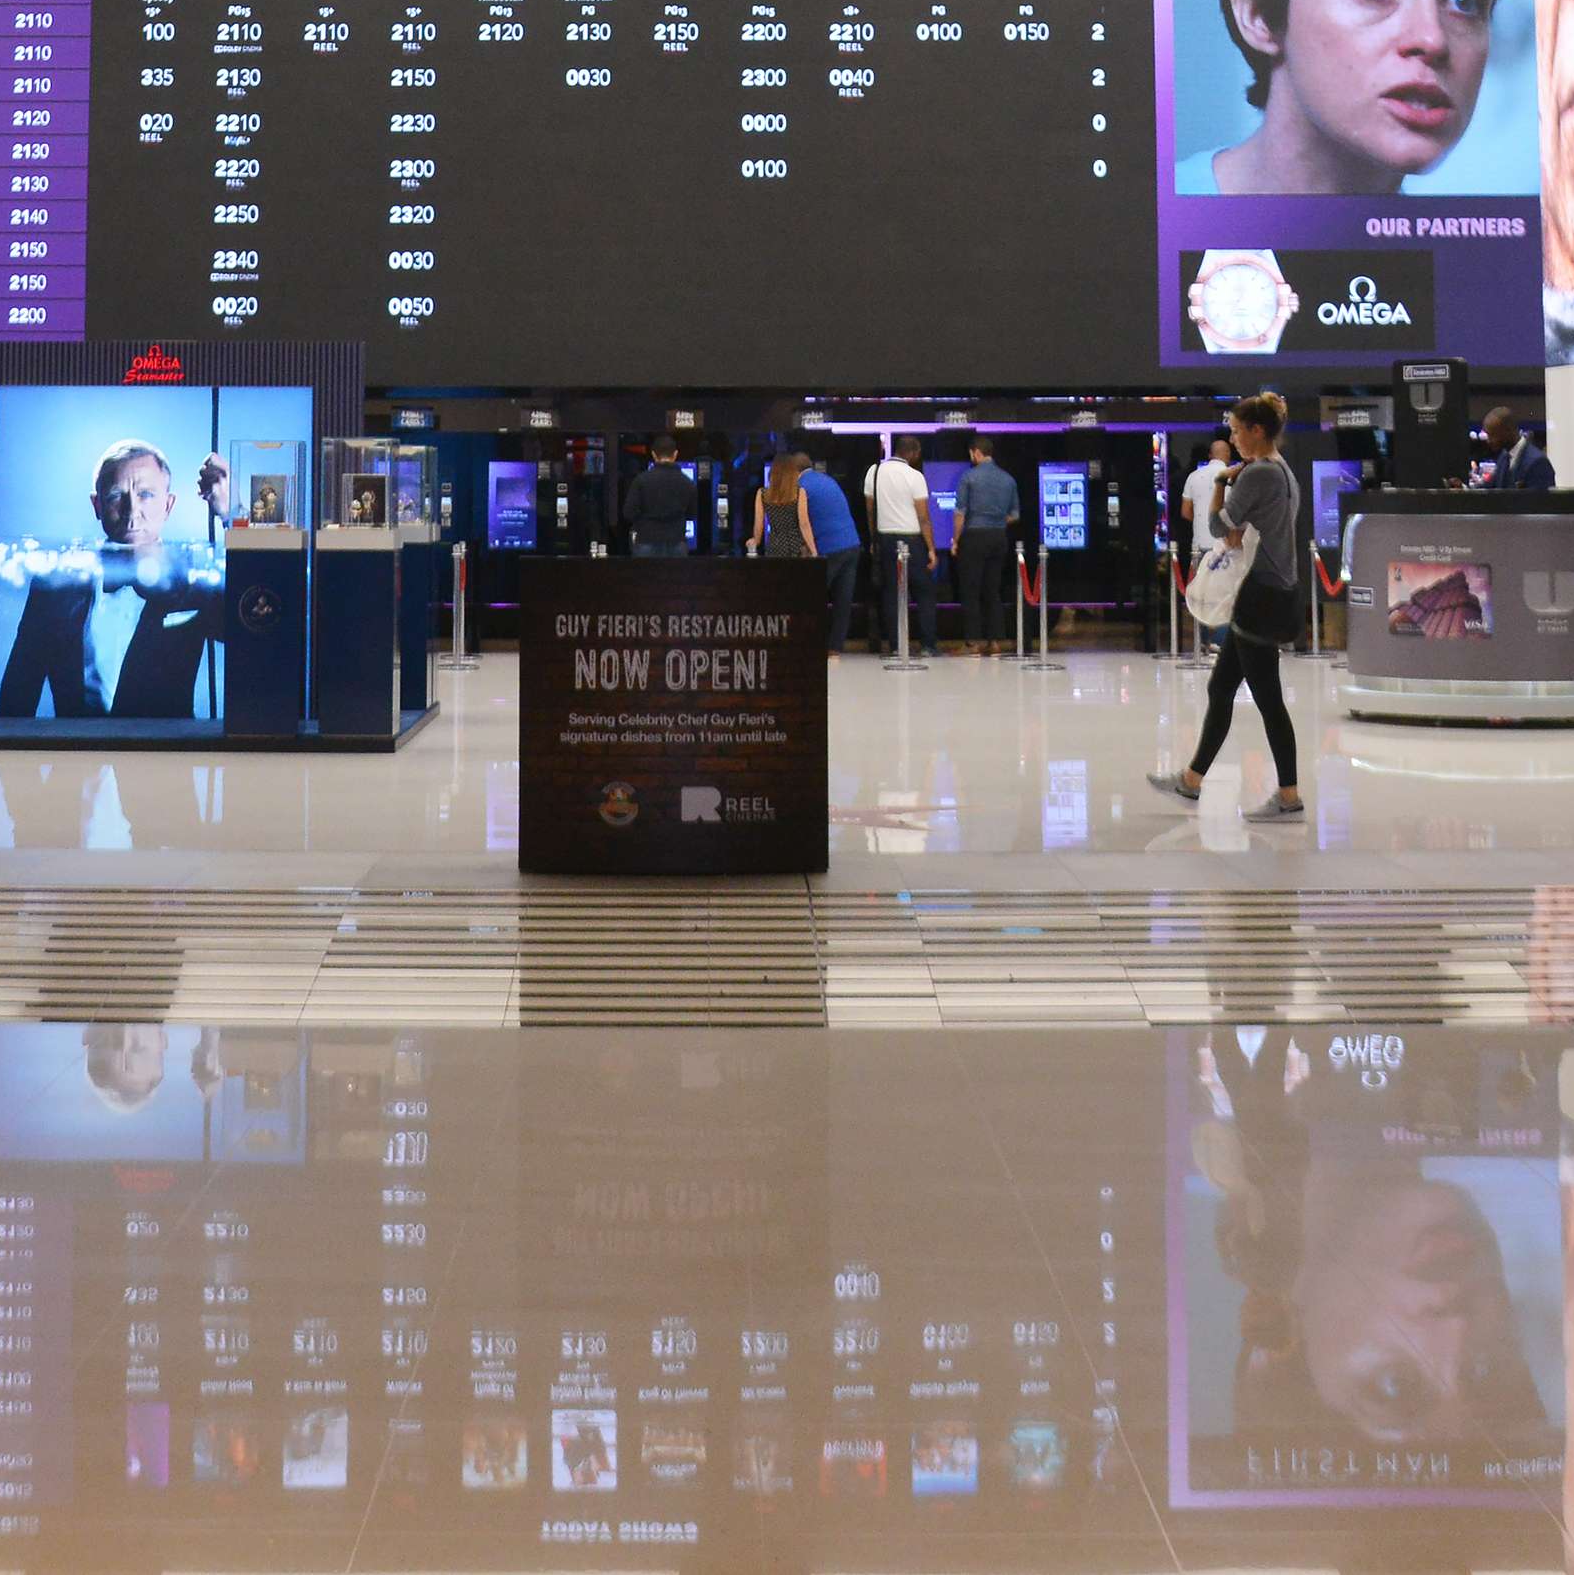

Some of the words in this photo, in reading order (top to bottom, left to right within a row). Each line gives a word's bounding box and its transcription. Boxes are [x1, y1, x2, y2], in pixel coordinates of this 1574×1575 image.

[228, 5, 252, 17] PG15
[489, 5, 513, 17] PG13
[581, 5, 595, 16] PG
[664, 5, 688, 17] PG13
[752, 5, 776, 17] PG15
[932, 5, 946, 16] PG
[1019, 5, 1033, 16] PG
[14, 13, 53, 29] 2110
[142, 23, 175, 41] 100
[216, 23, 262, 41] 2110
[304, 23, 349, 41] 2110
[391, 23, 437, 41] 2110
[478, 23, 524, 41] 2120
[566, 23, 612, 41] 2130
[653, 23, 699, 41] 2150
[741, 23, 787, 41] 2200
[829, 23, 874, 41] 2210
[916, 23, 962, 41] 0100
[1004, 23, 1049, 41] 0150
[1091, 23, 1105, 41] 2
[13, 45, 52, 61] 2110
[313, 42, 339, 52] REEL
[663, 42, 688, 52] REEL
[838, 42, 864, 52] REEL
[12, 78, 51, 94] 2110
[216, 68, 261, 87] 2130
[390, 68, 436, 87] 2150
[565, 68, 611, 87] 0030
[741, 68, 787, 87] 2300
[829, 68, 875, 87] 0040
[1092, 68, 1106, 87] 2
[838, 88, 864, 97] REEL
[12, 110, 51, 126] 2120
[139, 113, 174, 132] 020
[215, 113, 261, 132] 2210
[390, 113, 436, 132] 2230
[741, 113, 787, 132] 0000
[1092, 113, 1107, 132] 0
[12, 143, 50, 160] 2130
[214, 159, 260, 178] 2220
[389, 159, 435, 178] 2300
[741, 159, 787, 178] 0100
[1092, 159, 1107, 178] 0
[11, 176, 49, 192] 2130
[10, 209, 48, 225] 2140
[213, 205, 259, 223] 2250
[389, 205, 435, 224] 2320
[1365, 218, 1411, 237] OUR
[1416, 218, 1525, 237] PARTNERS
[9, 242, 48, 258] 2150
[212, 250, 259, 269] 2340
[388, 251, 434, 269] 0030
[9, 275, 47, 291] 2150
[212, 296, 258, 315] 0020
[388, 297, 434, 315] 0050
[1317, 301, 1412, 326] OMEGA
[8, 307, 46, 324] 2200
[132, 356, 181, 370] OMEGA
[122, 368, 185, 383] Seamaster
[555, 614, 591, 638] GUY
[597, 614, 662, 638] FIERI'S
[668, 614, 791, 638] RESTAURANT
[574, 648, 651, 690] NOW
[664, 648, 768, 691] OPEN!
[568, 712, 616, 727] Serving
[618, 712, 675, 727] Celebrity
[677, 712, 708, 725] Chef
[710, 713, 735, 727] Guy
[738, 712, 775, 726] Fieri's
[559, 730, 618, 744] signature
[620, 730, 663, 743] dishes
[664, 730, 696, 743] from
[699, 730, 733, 743] 11am
[735, 730, 763, 743] until
[764, 730, 787, 743] late
[725, 797, 775, 812] REEL
